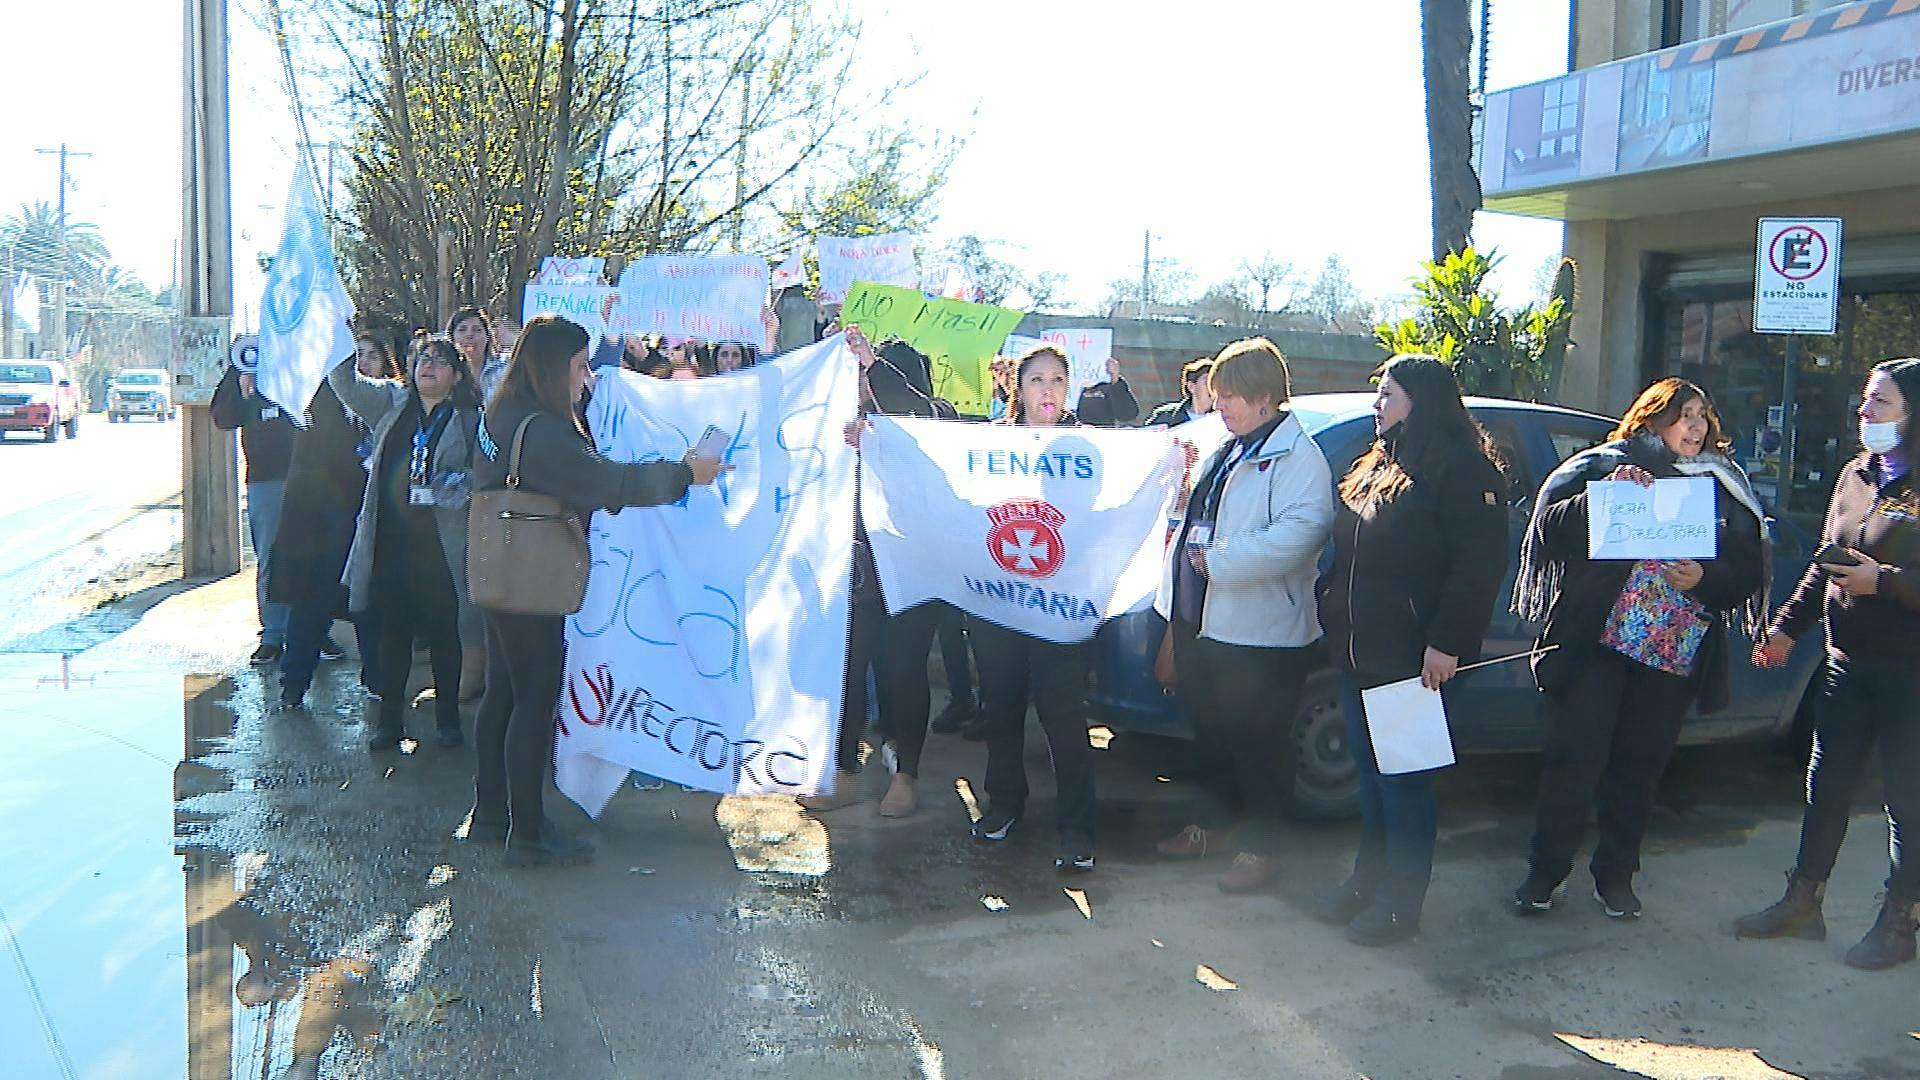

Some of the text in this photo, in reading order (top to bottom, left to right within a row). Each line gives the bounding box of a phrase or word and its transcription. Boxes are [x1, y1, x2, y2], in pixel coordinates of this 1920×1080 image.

[1763, 291, 1828, 299] ESTACIONAR
[1786, 281, 1805, 290] NO
[850, 290, 893, 319] NO
[966, 450, 1094, 479] FENATS
[962, 574, 1101, 621] UNITARIA
